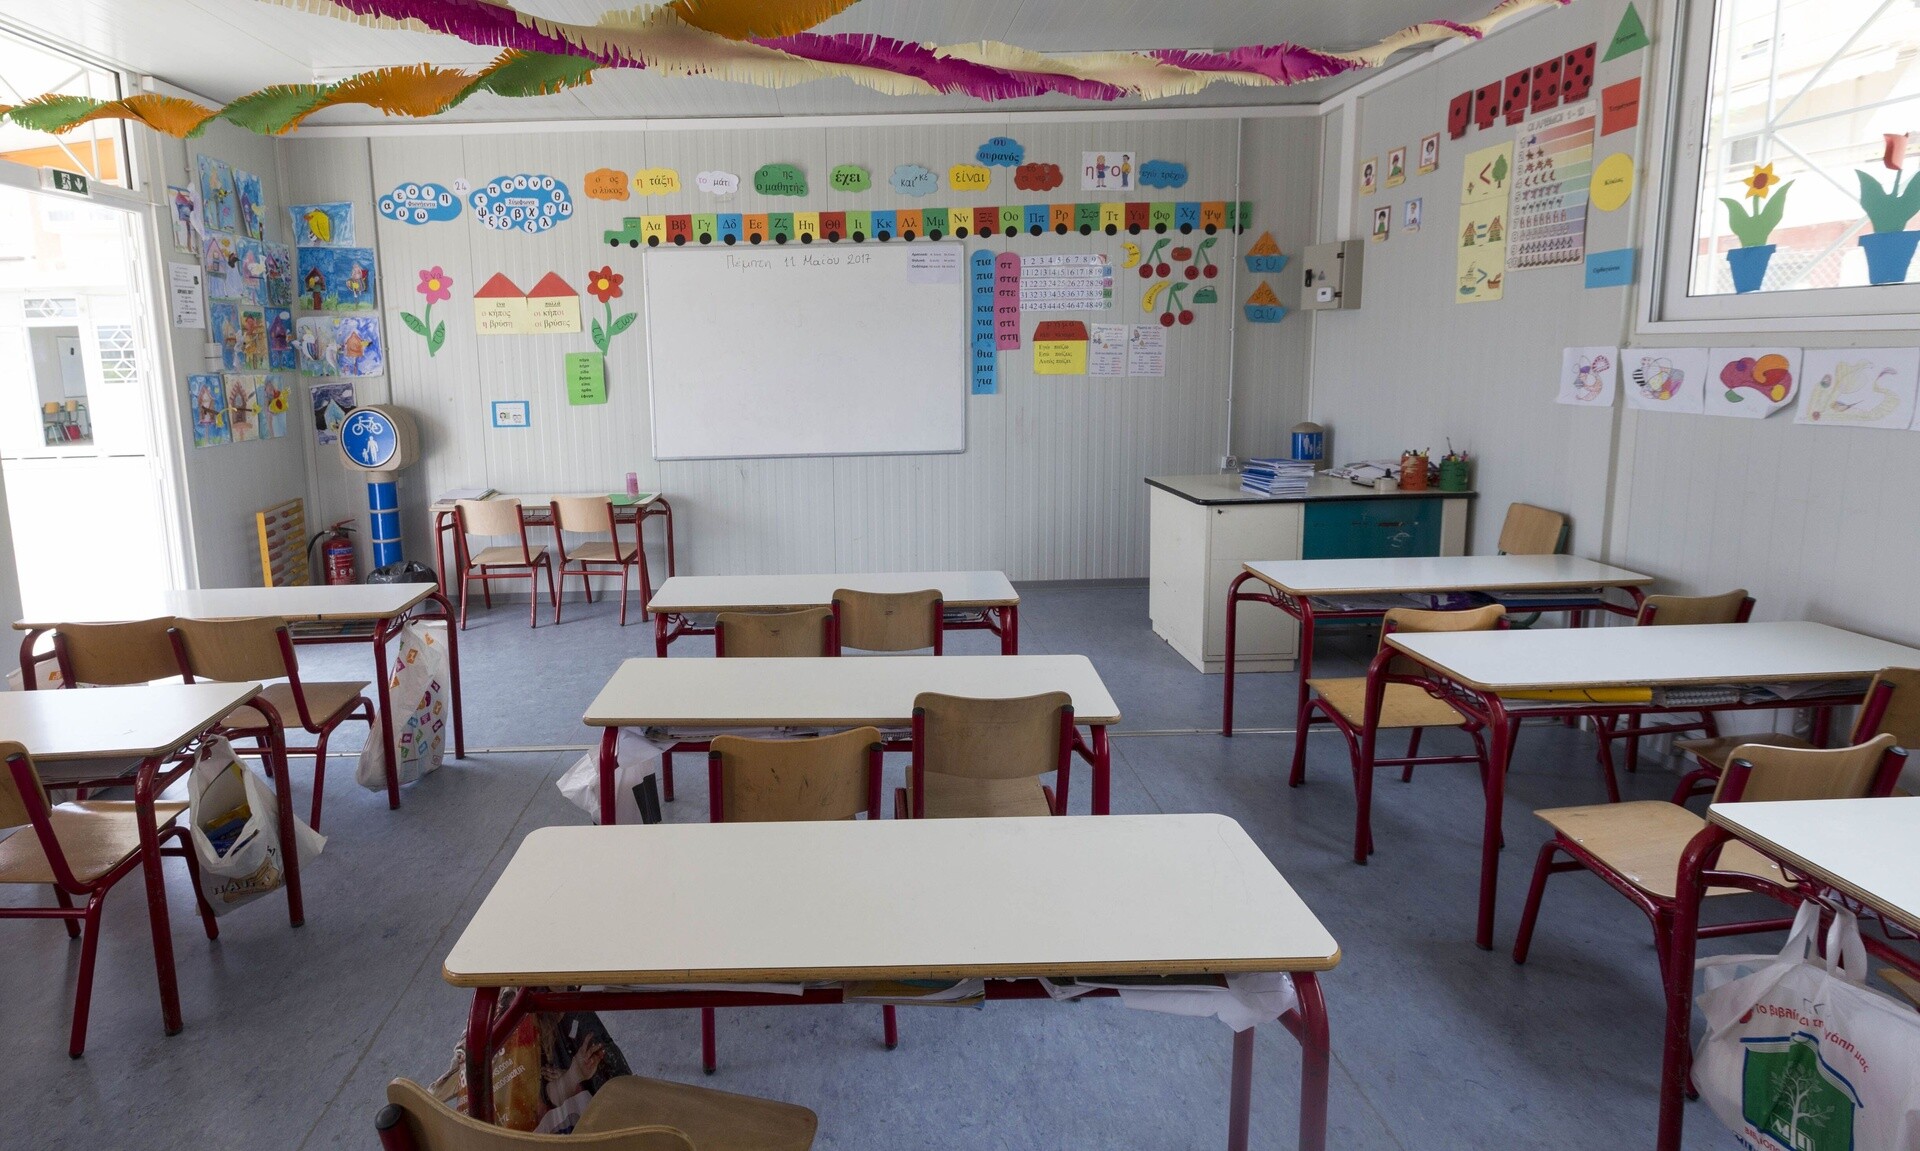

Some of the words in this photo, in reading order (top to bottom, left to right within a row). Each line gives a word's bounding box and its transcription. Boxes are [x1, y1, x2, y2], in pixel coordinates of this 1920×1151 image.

[980, 152, 1019, 163] ουρανός
[956, 172, 985, 182] είναι
[1086, 166, 1094, 179] η
[1111, 166, 1120, 176] ο
[637, 178, 643, 188] η
[650, 175, 674, 187] τάξη
[835, 170, 861, 185] έχει
[455, 181, 466, 190] 24
[765, 182, 804, 193] μαθητής
[600, 186, 623, 195] λύκος
[442, 194, 448, 204] η
[546, 180, 551, 188] ρ
[555, 192, 560, 201] θ
[561, 204, 568, 212] μ
[478, 207, 486, 218] ψ
[496, 204, 503, 214] φ
[515, 209, 521, 220] β
[502, 218, 508, 227] δ
[542, 218, 548, 227] λ
[646, 222, 661, 230] Αα
[672, 220, 686, 231] Ββ
[698, 220, 710, 231] Γγ
[723, 219, 737, 229] Δδ
[749, 220, 762, 229] Εε
[774, 218, 787, 229] Ζζ
[799, 221, 814, 231] Ηη
[825, 220, 840, 229] Θθ
[855, 220, 862, 229] Ιι
[877, 219, 892, 228] Κκ
[902, 218, 917, 228] Λλ
[927, 217, 944, 229] Μμ
[954, 213, 968, 223] Νν
[979, 213, 992, 224] Ξξ
[1003, 212, 1019, 221] Οο
[1030, 213, 1044, 223] Ππ
[1055, 210, 1068, 221] Ρρ
[1106, 211, 1119, 221] Ττ
[1130, 210, 1145, 220] Υυ
[1154, 210, 1170, 221] Φφ
[1180, 208, 1195, 219] Χχ
[1205, 210, 1221, 221] Ψψ
[726, 254, 771, 273] Πέμπτη
[785, 256, 796, 267] 11
[847, 254, 871, 265] 2017
[489, 309, 510, 318] κήπος
[543, 309, 564, 317] κήποι
[490, 320, 513, 328] βρύση
[544, 320, 570, 328] βρύσες
[977, 333, 993, 341] ρια
[1001, 334, 1019, 342] στη
[977, 349, 993, 358] θια
[977, 365, 993, 374] μια
[977, 378, 992, 387] για
[1769, 1005, 1799, 1021] βιβλί
[1824, 1028, 1854, 1053] γάπη
[1854, 1051, 1869, 1073] μας
